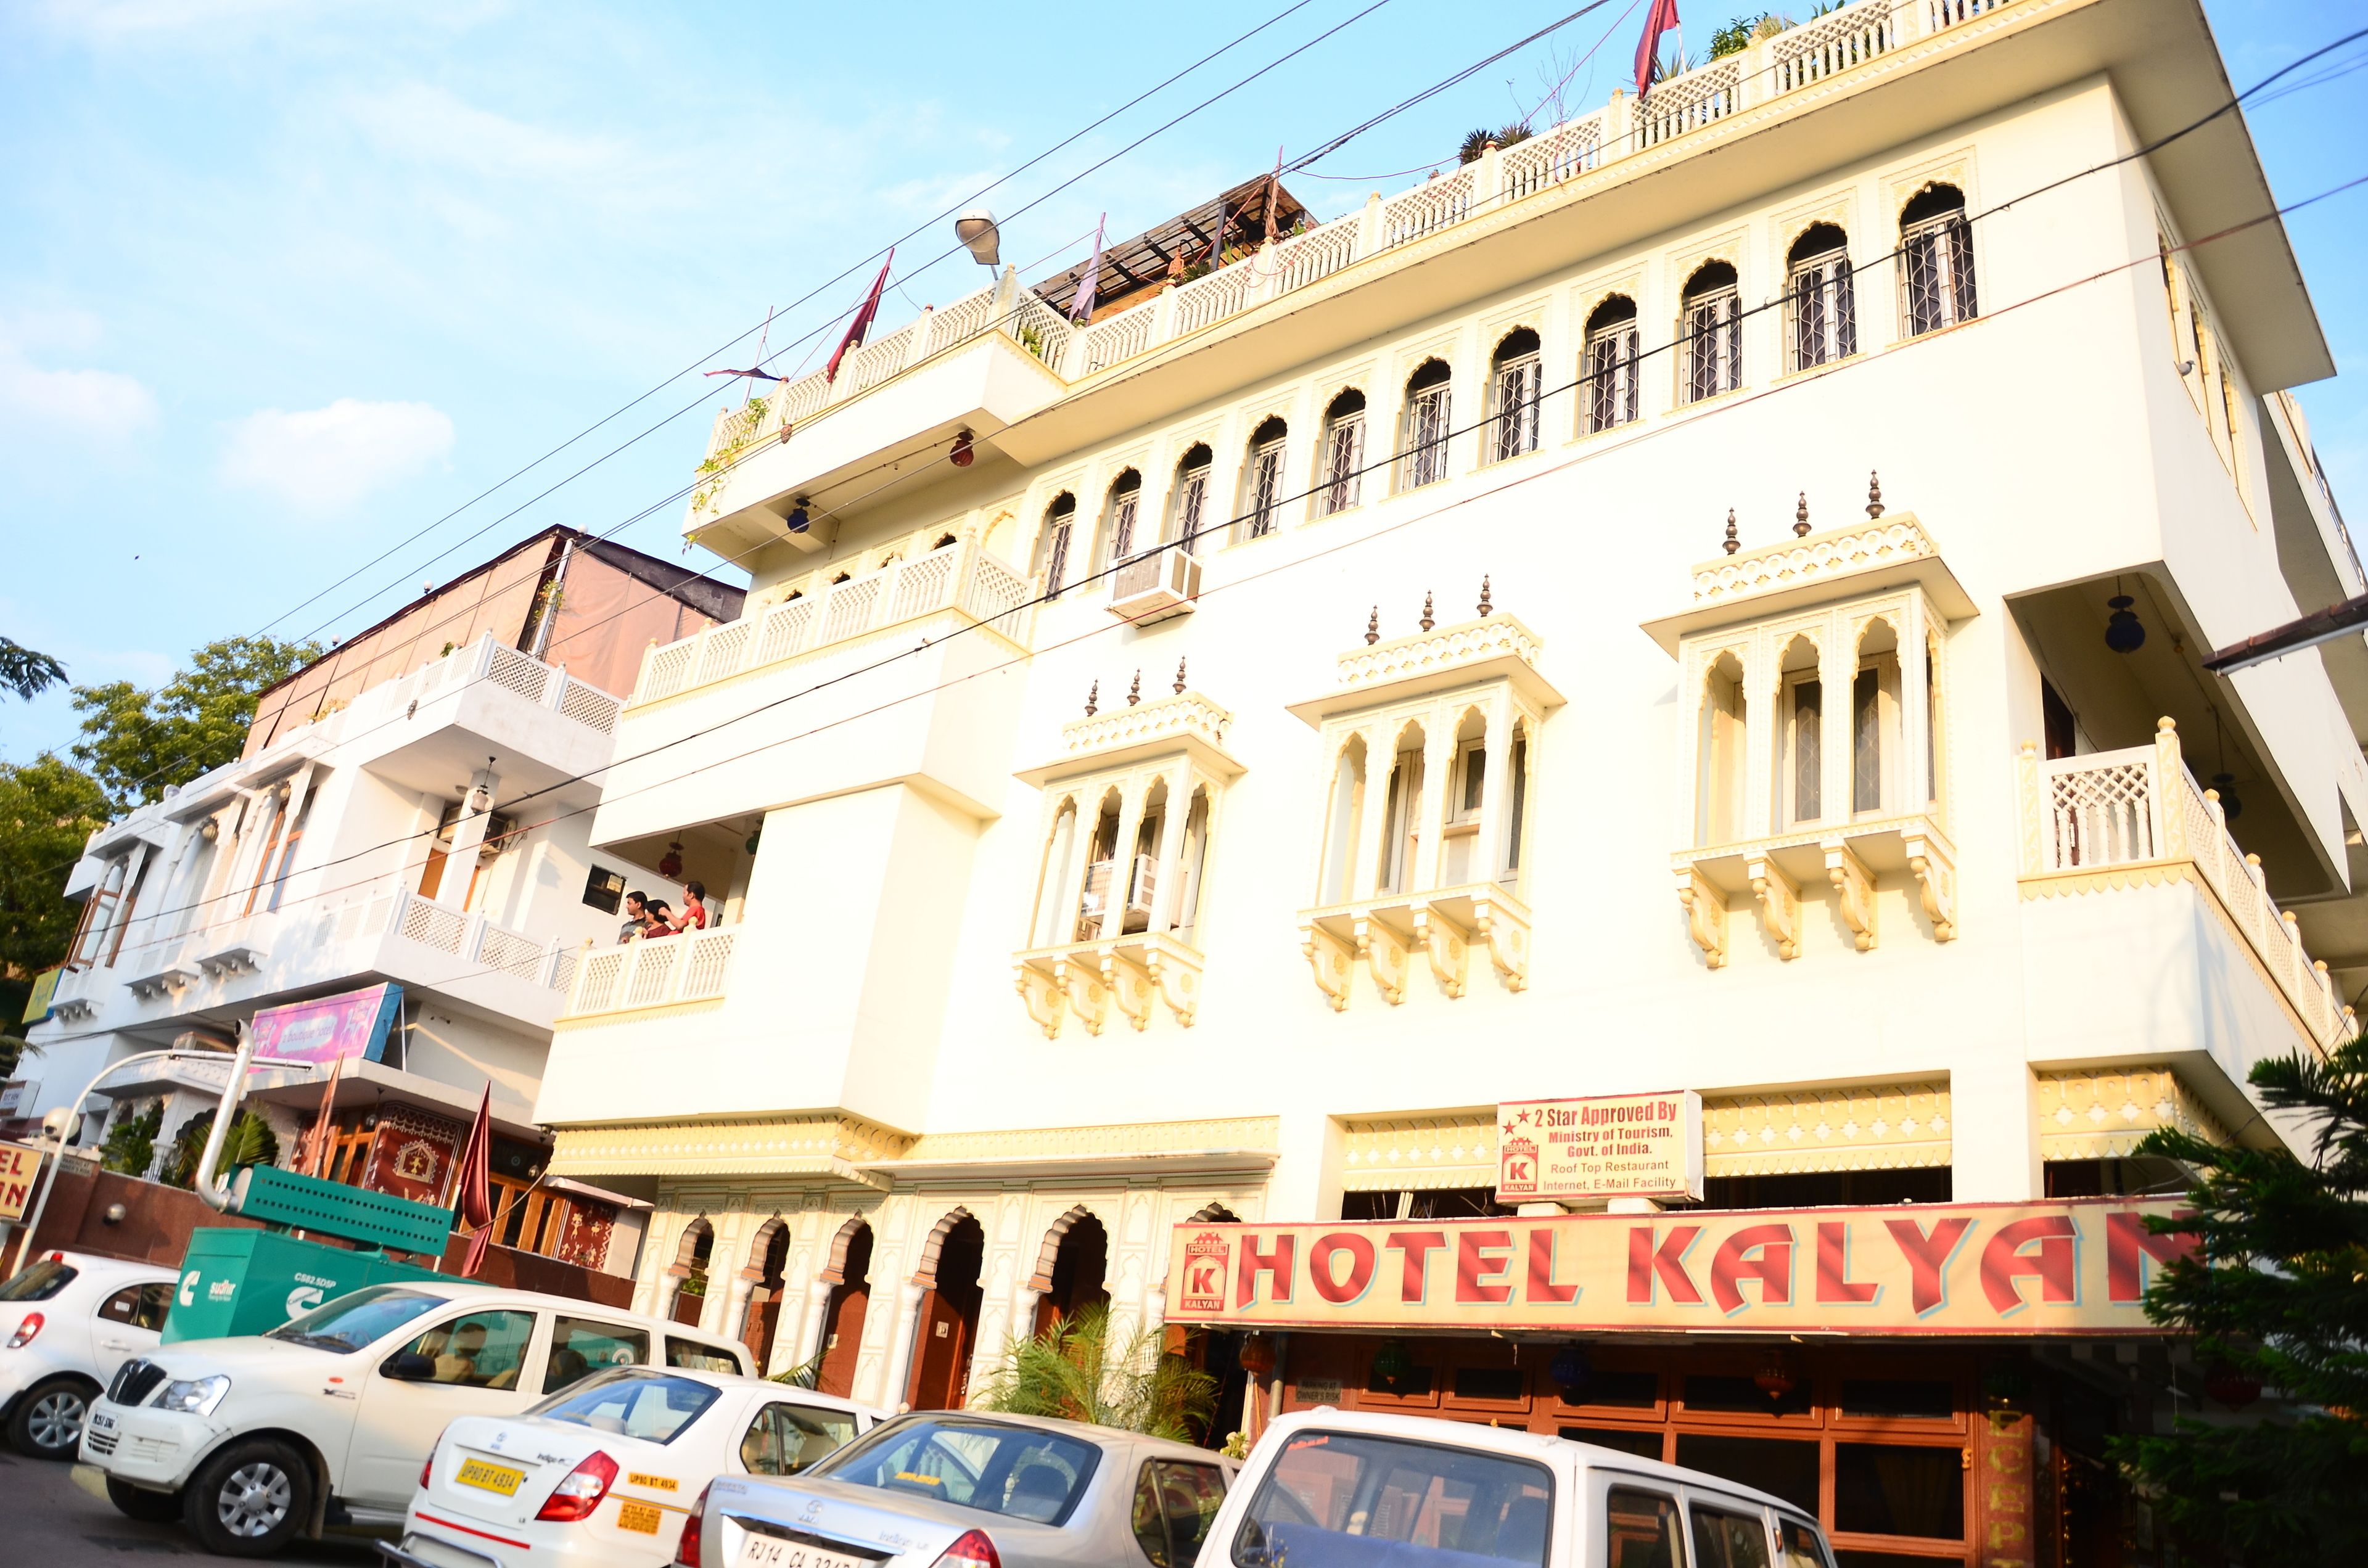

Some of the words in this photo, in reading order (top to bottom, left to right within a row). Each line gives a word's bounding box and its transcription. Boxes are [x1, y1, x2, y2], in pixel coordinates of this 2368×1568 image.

[287, 1030, 315, 1043] boutique
[1535, 1109, 1543, 1127] 2
[1547, 1108, 1577, 1127] Star
[1581, 1102, 1654, 1126] Approved
[1658, 1101, 1676, 1122] By
[1548, 1130, 1599, 1143] Ministry
[1602, 1128, 1614, 1140] of
[1618, 1127, 1673, 1139] Tourism,
[1568, 1146, 1598, 1157] Govt.
[1601, 1144, 1613, 1156] of
[1617, 1143, 1652, 1155] India.
[1510, 1162, 1529, 1180] K
[1551, 1164, 1577, 1174] Roof
[1581, 1162, 1601, 1175] Top
[1605, 1160, 1669, 1172] Restaurant
[1544, 1180, 1590, 1191] Internet,
[1594, 1178, 1629, 1189] E-Mail
[1634, 1176, 1676, 1189] Facility
[1190, 1246, 1225, 1254] HOTEL
[1237, 1229, 1581, 1310] HOTEL
[1192, 1268, 1215, 1294] K
[1184, 1300, 1220, 1309] KALYAN
[747, 1541, 783, 1564] RJ14
[789, 1551, 806, 1568] CA
